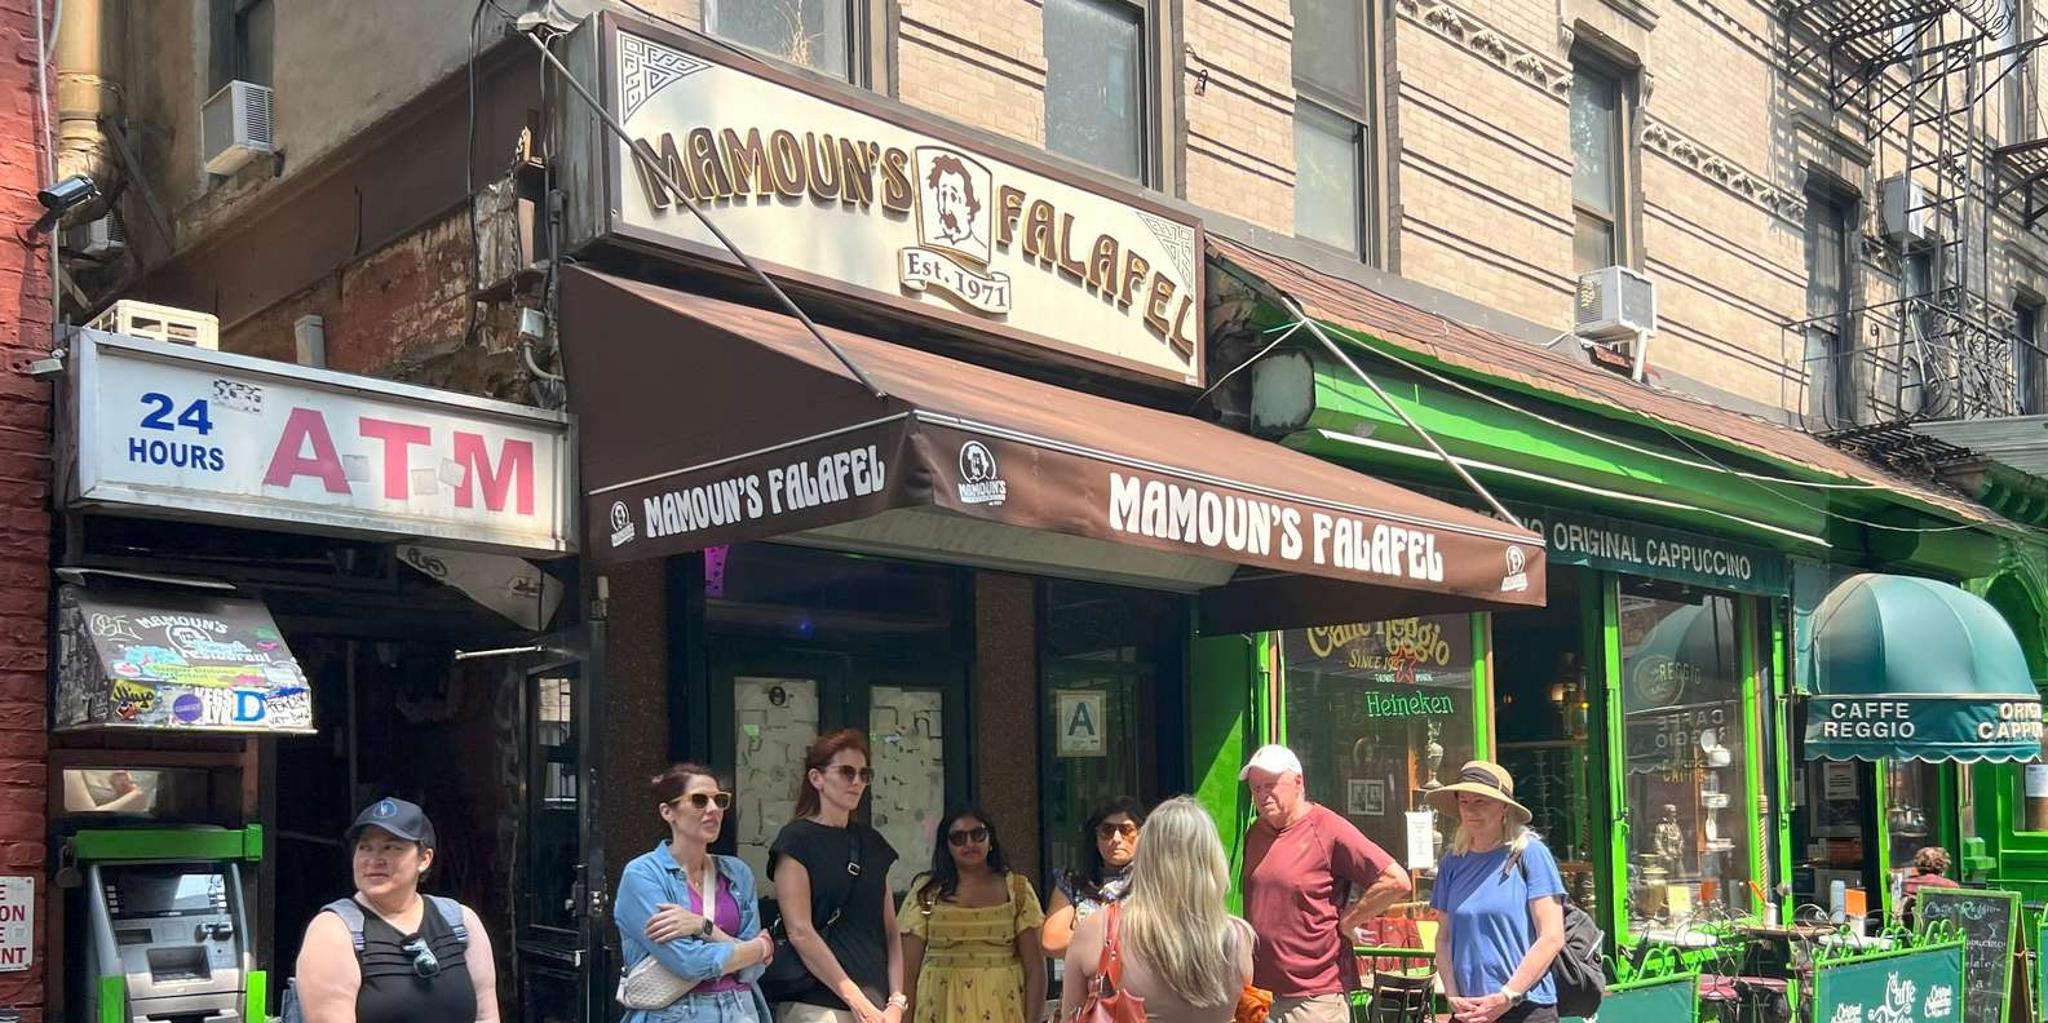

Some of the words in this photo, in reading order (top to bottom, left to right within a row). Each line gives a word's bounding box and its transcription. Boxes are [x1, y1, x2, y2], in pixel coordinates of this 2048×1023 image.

[633, 127, 912, 212] MAMOUN'S
[996, 183, 1196, 361] FALAFEL
[906, 254, 950, 284] Est.
[955, 273, 1007, 308] 1971
[140, 392, 213, 435] 24
[128, 437, 224, 472] HOURS
[643, 474, 764, 539] MAMOUN'S
[767, 444, 886, 515] FALAFEL
[1109, 472, 1303, 560] MAMOUN'S
[1312, 512, 1444, 582] FALAFEL
[1553, 522, 1642, 563] ORIGINAL
[1646, 540, 1752, 580] CAPPUCCINO
[1067, 701, 1096, 736] A
[1365, 690, 1454, 717] Heineken
[1831, 703, 1910, 719] CAFFE
[1823, 721, 1916, 739] REGGIO
